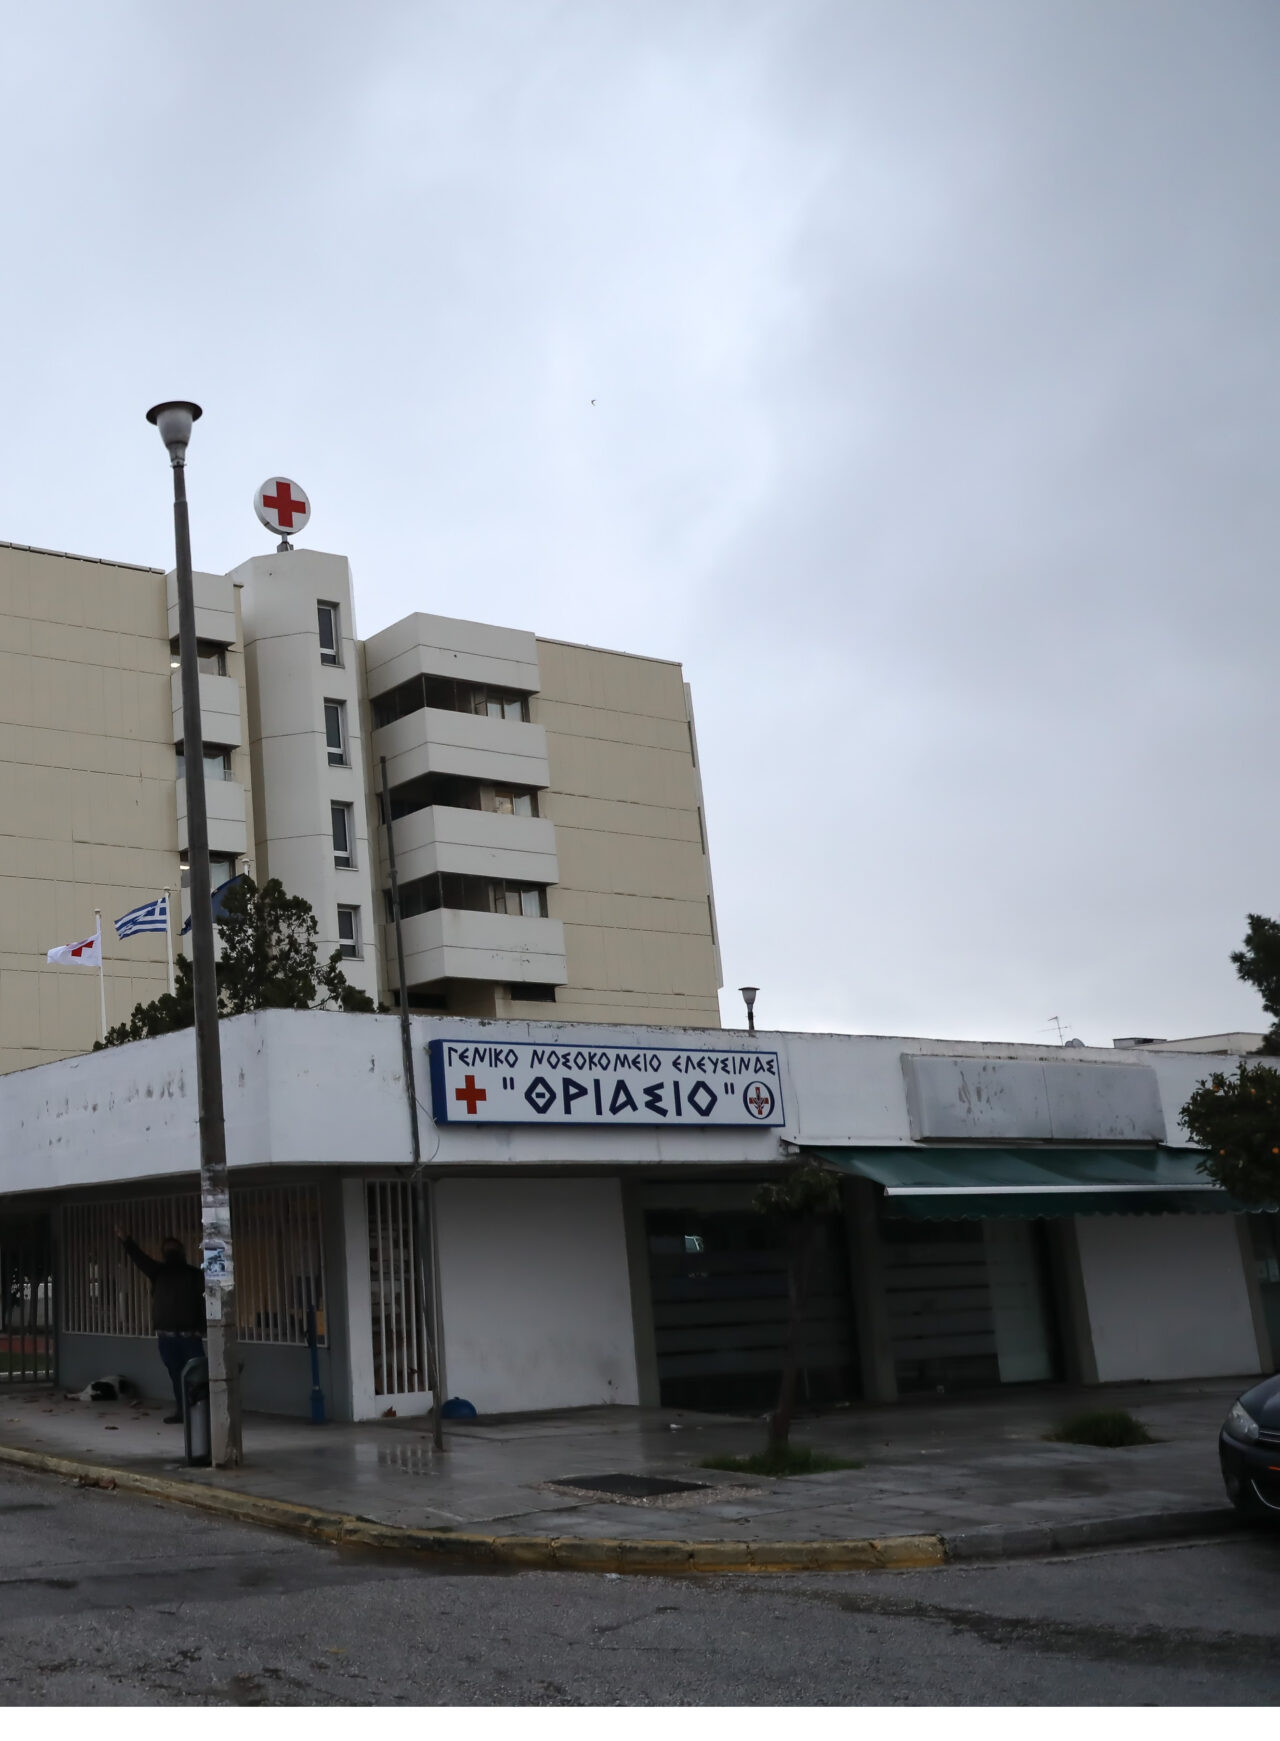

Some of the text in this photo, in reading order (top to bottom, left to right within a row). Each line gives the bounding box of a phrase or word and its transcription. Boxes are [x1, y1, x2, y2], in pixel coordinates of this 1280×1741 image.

[447, 1046, 777, 1076] ΓΕΝΙΚΟ ΝΟΣΟΚΟΜΕΙΟ ΕΛΕΥΣΙΝΑΣ
[502, 1076, 735, 1118] "ΘΡΙΑΣΙΟ"
